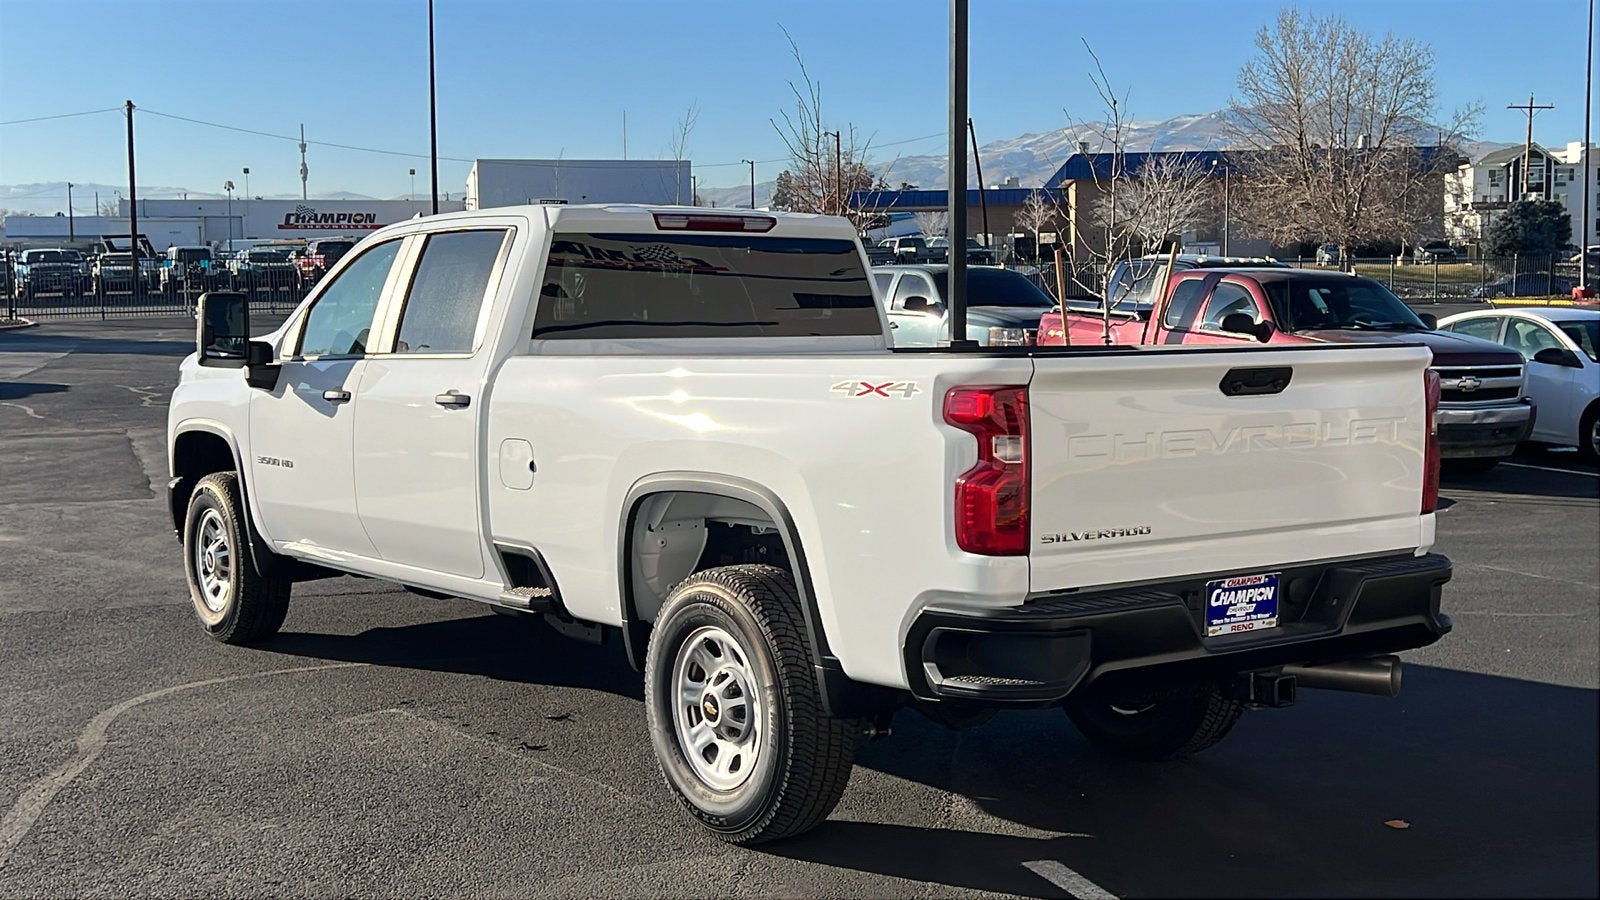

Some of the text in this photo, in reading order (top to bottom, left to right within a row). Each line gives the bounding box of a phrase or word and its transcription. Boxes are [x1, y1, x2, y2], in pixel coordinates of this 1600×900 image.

[284, 212, 377, 225] CHAMPION
[1067, 416, 1408, 461] CHEVROLET
[257, 455, 294, 468] 3500 HD
[1041, 526, 1152, 544] SILVERADO
[1227, 577, 1262, 587] CHAMPION
[1211, 586, 1275, 607] CHAMPION
[1229, 605, 1255, 613] CHEVROLET
[1231, 622, 1254, 632] RENO
